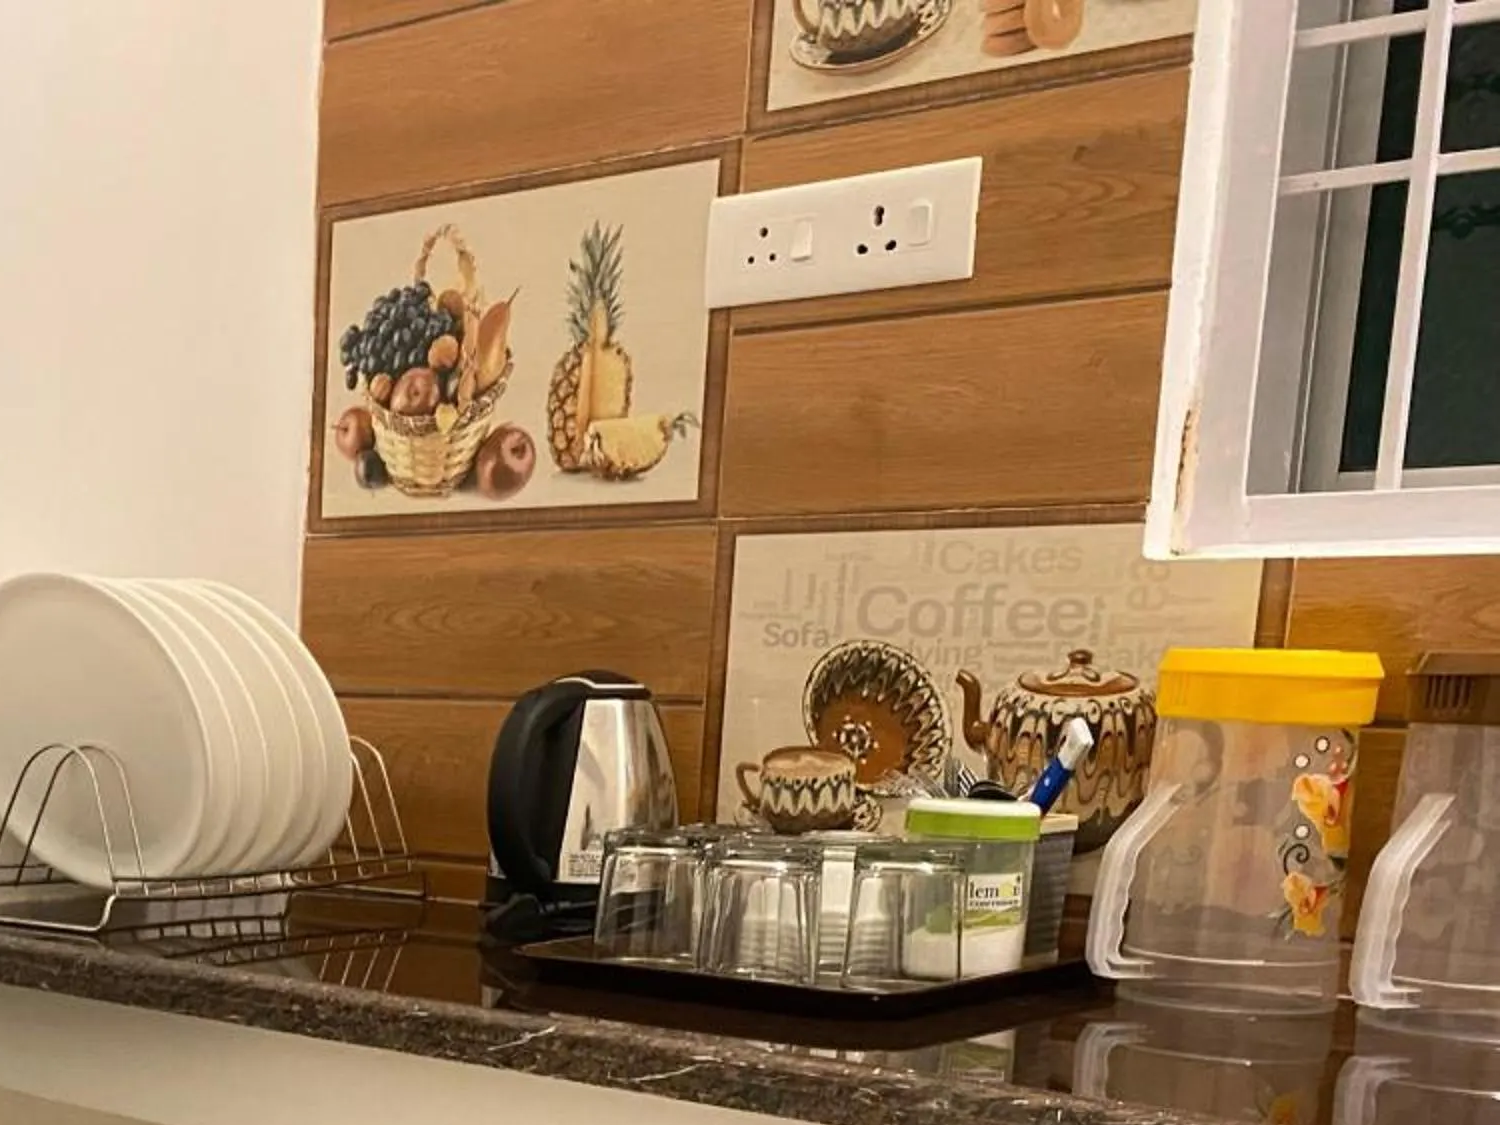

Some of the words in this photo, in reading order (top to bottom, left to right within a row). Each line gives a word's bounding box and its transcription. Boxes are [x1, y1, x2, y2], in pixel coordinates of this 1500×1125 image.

[939, 537, 1083, 575] Cakes
[857, 582, 1089, 638] Coffee
[762, 621, 829, 648] Sofa
[907, 637, 983, 671] iving
